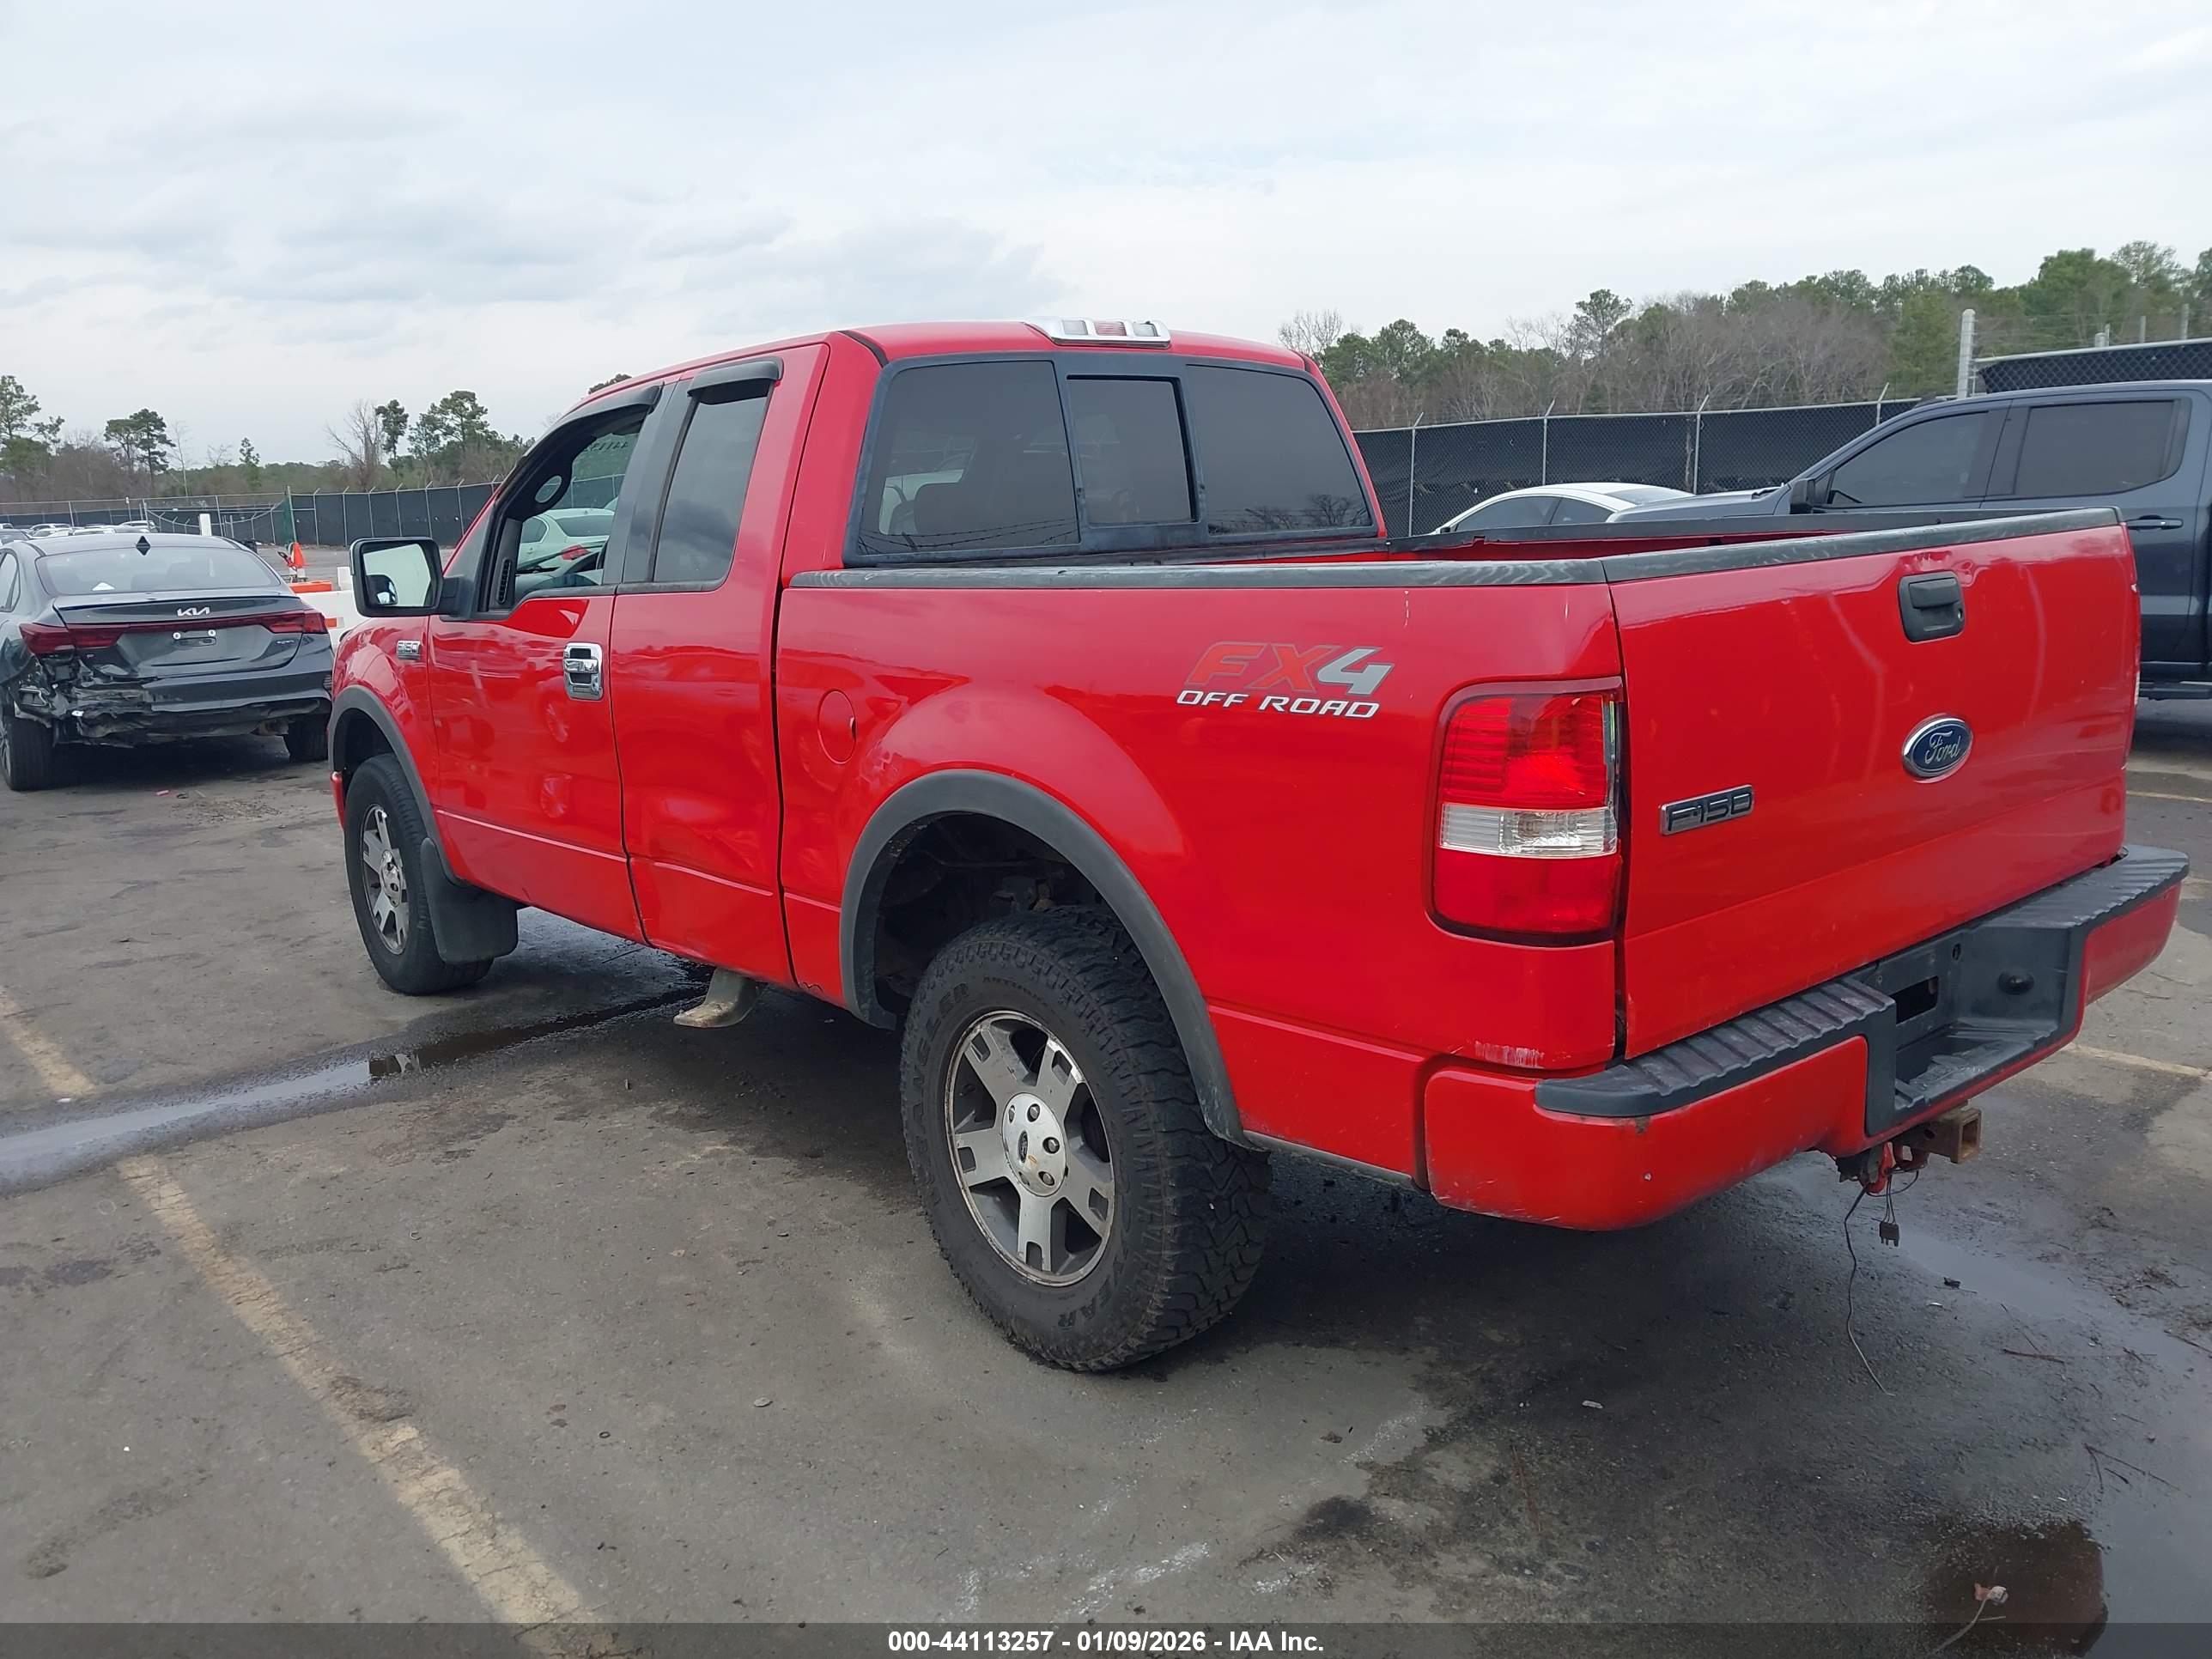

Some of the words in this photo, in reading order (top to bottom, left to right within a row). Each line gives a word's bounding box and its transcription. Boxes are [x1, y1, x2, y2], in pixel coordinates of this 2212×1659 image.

[1184, 641, 1395, 696] FX4
[1176, 690, 1249, 708] OFF
[1259, 696, 1381, 719] ROAD
[1924, 731, 1961, 765] Ford
